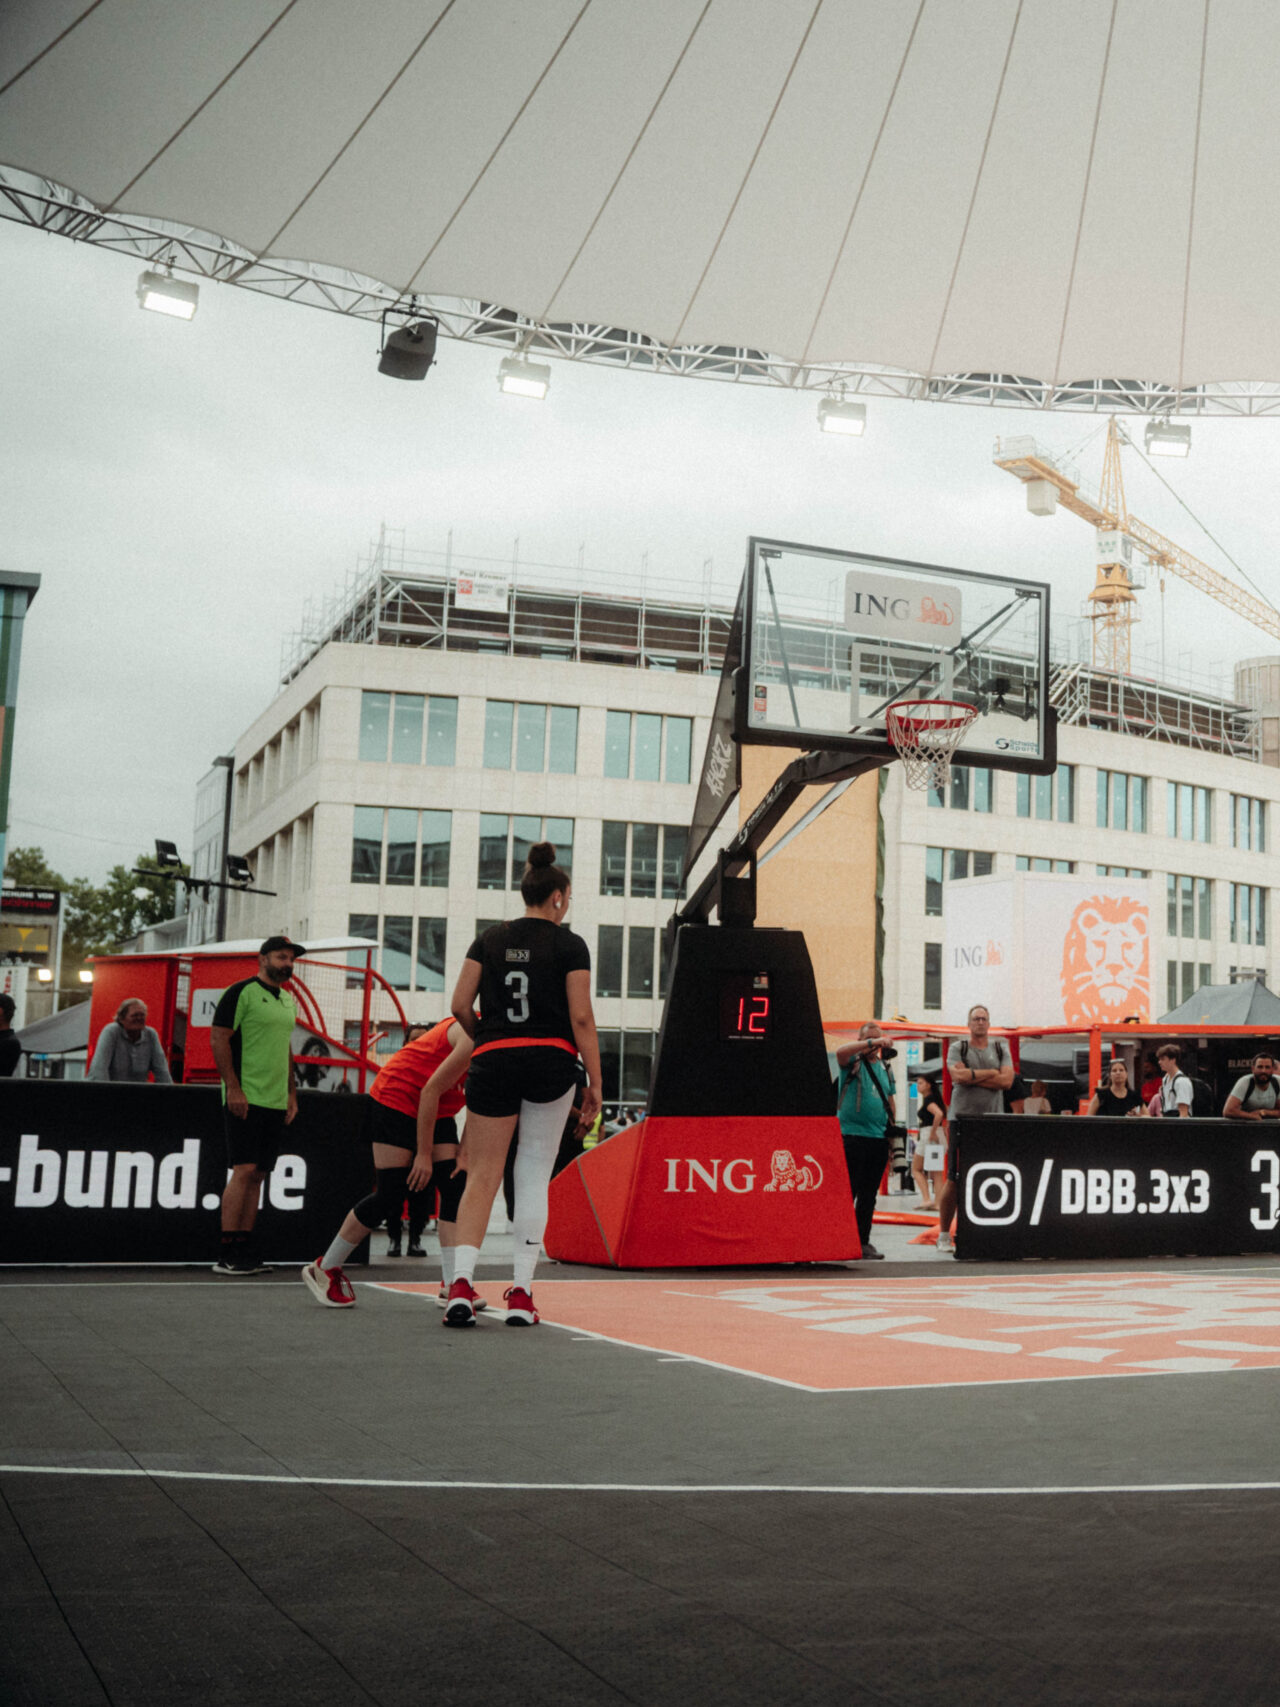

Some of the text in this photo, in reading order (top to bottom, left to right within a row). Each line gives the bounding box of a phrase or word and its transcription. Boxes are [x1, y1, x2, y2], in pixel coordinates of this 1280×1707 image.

[853, 592, 910, 620] ING
[954, 945, 982, 968] ING
[505, 970, 529, 1023] 3
[737, 996, 769, 1032] 12
[663, 1158, 757, 1193] ING
